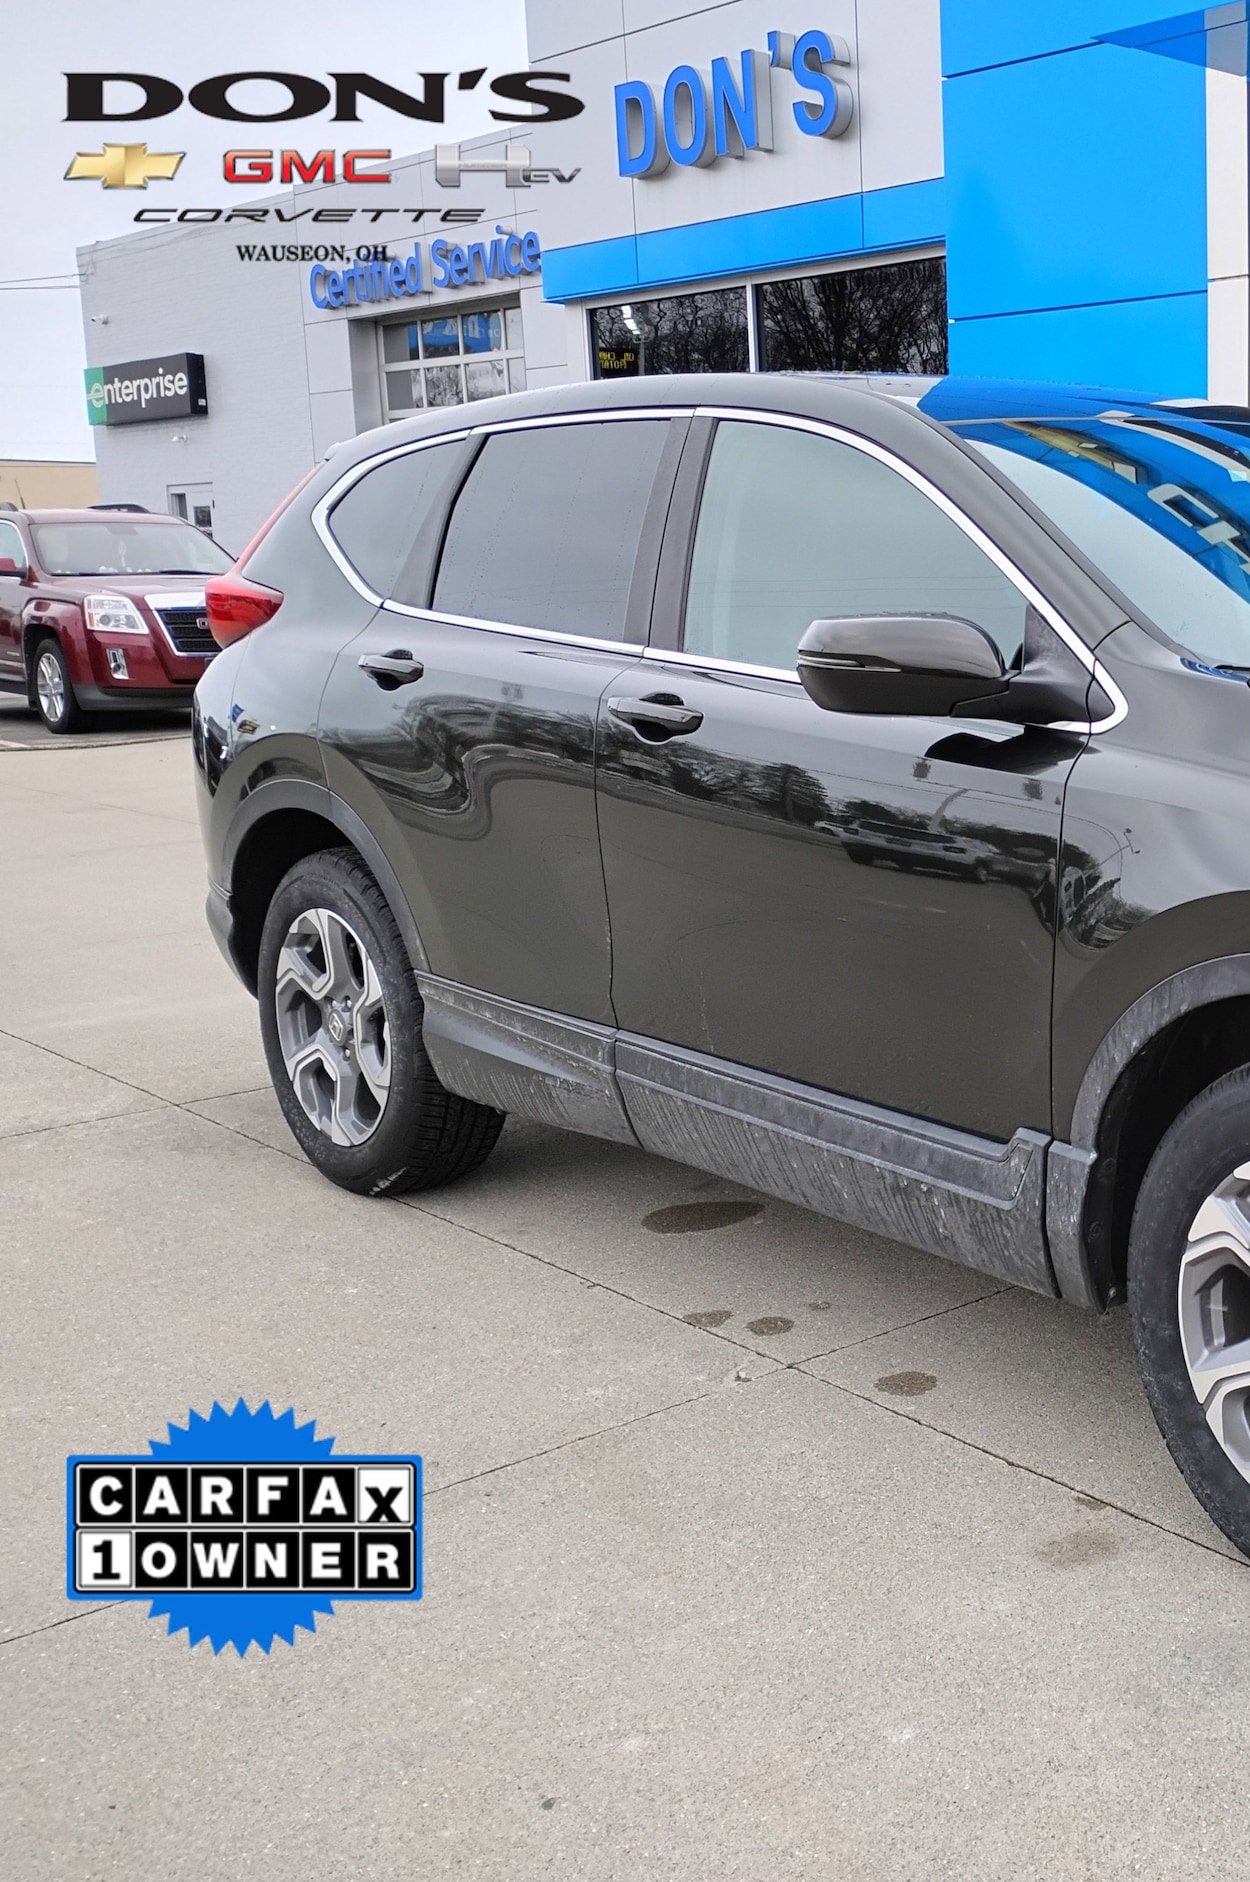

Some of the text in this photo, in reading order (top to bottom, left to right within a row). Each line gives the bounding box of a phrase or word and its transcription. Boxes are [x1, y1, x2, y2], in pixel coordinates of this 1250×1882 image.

[614, 30, 850, 178] DON'S
[310, 225, 543, 309] Certified Service
[88, 367, 189, 409] enterprise
